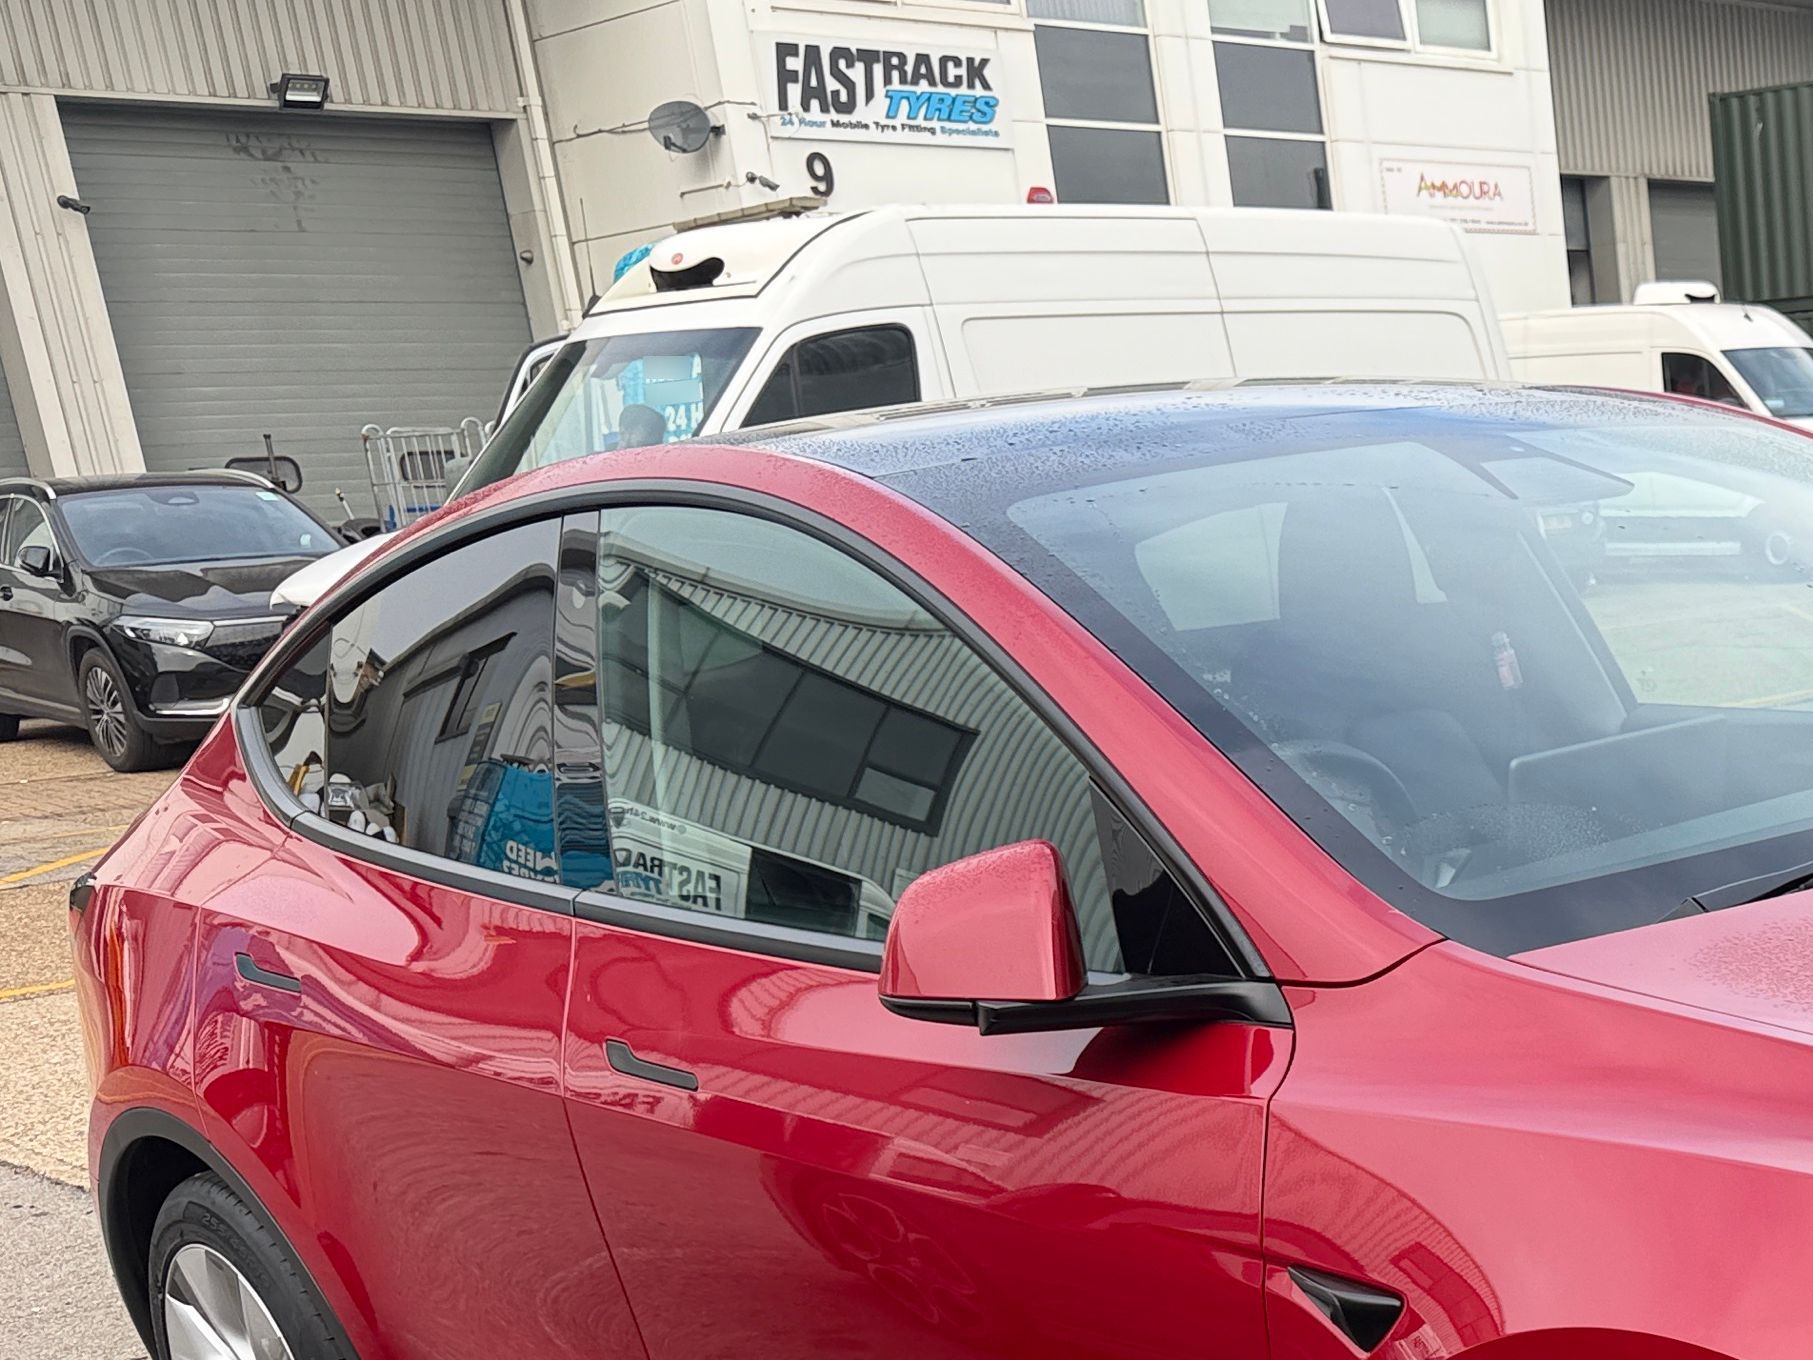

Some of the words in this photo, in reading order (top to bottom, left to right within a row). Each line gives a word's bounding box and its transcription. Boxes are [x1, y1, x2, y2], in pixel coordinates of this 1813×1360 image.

[775, 41, 993, 114] FASTRACK
[884, 88, 999, 125] TYRES
[830, 118, 870, 131] Mobile
[873, 121, 898, 134] Tyre
[901, 124, 937, 136] Fitting
[806, 151, 835, 198] 9
[1416, 172, 1503, 201] AMMOURA
